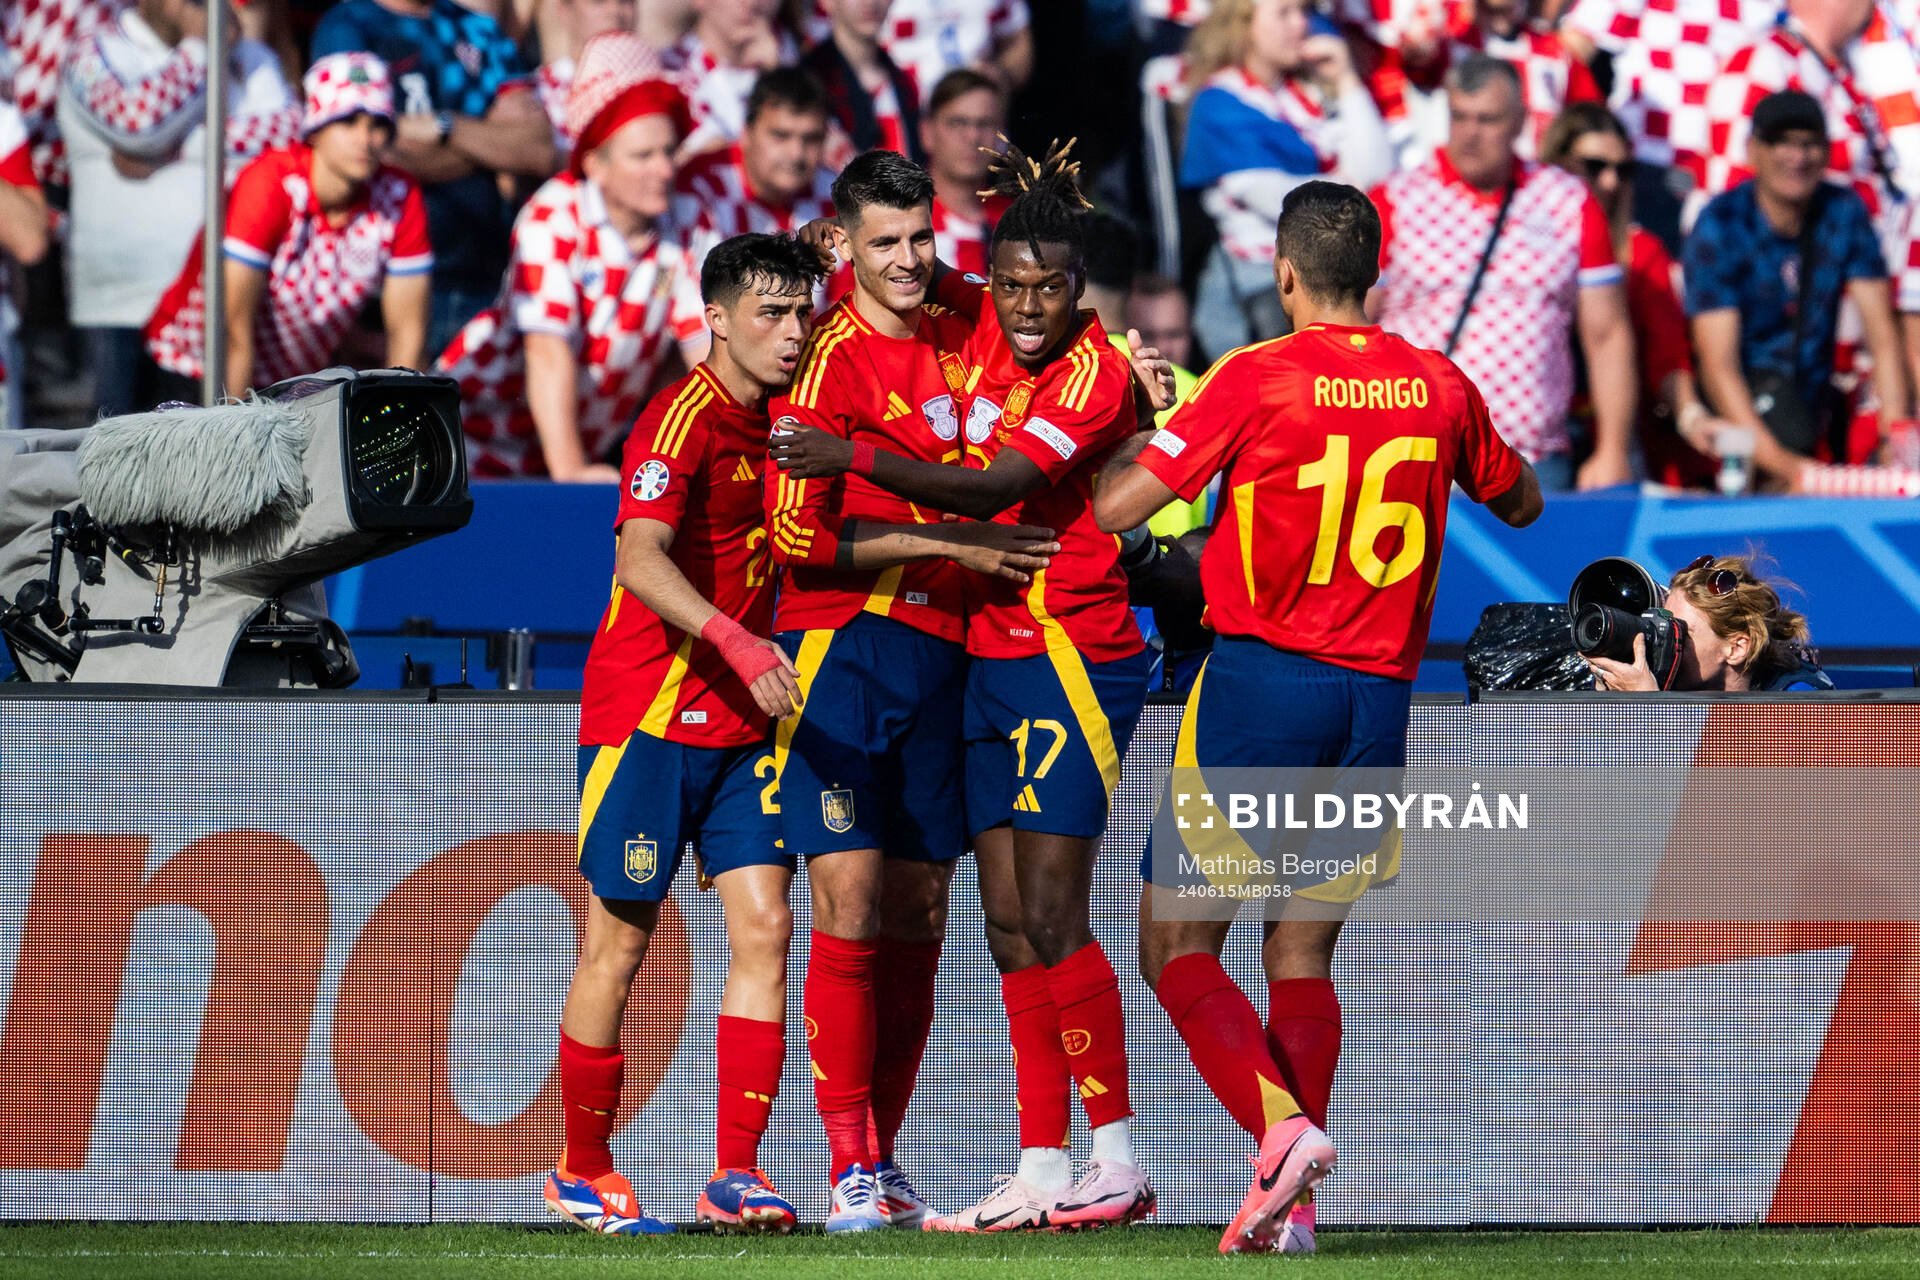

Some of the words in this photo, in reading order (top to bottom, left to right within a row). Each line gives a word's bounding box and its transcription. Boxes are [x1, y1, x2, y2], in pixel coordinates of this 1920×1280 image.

[1314, 375, 1429, 410] RODRIGO
[1296, 434, 1437, 588] 16
[1009, 718, 1068, 779] 17
[0, 829, 690, 1179] no
